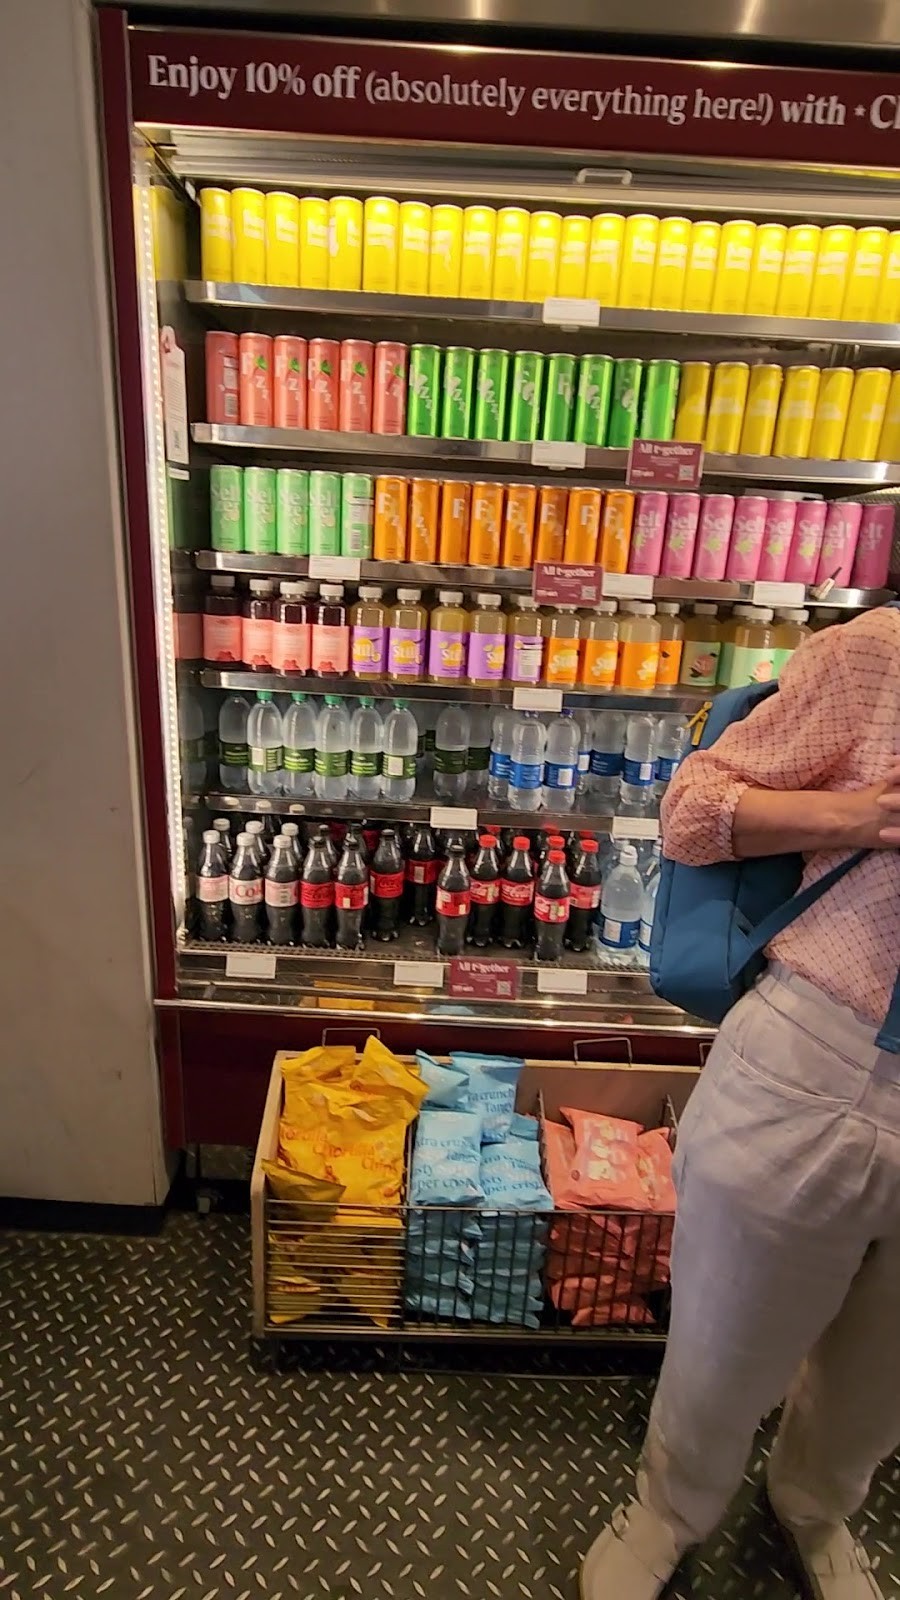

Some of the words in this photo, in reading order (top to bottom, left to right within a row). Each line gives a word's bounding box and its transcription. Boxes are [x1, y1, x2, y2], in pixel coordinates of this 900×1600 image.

[148, 55, 238, 99] Enjoy
[245, 62, 305, 96] 10%
[312, 65, 361, 98] off
[365, 70, 526, 116] (absolutely
[531, 85, 688, 125] everything
[693, 88, 774, 126] here!)
[780, 94, 846, 126] with
